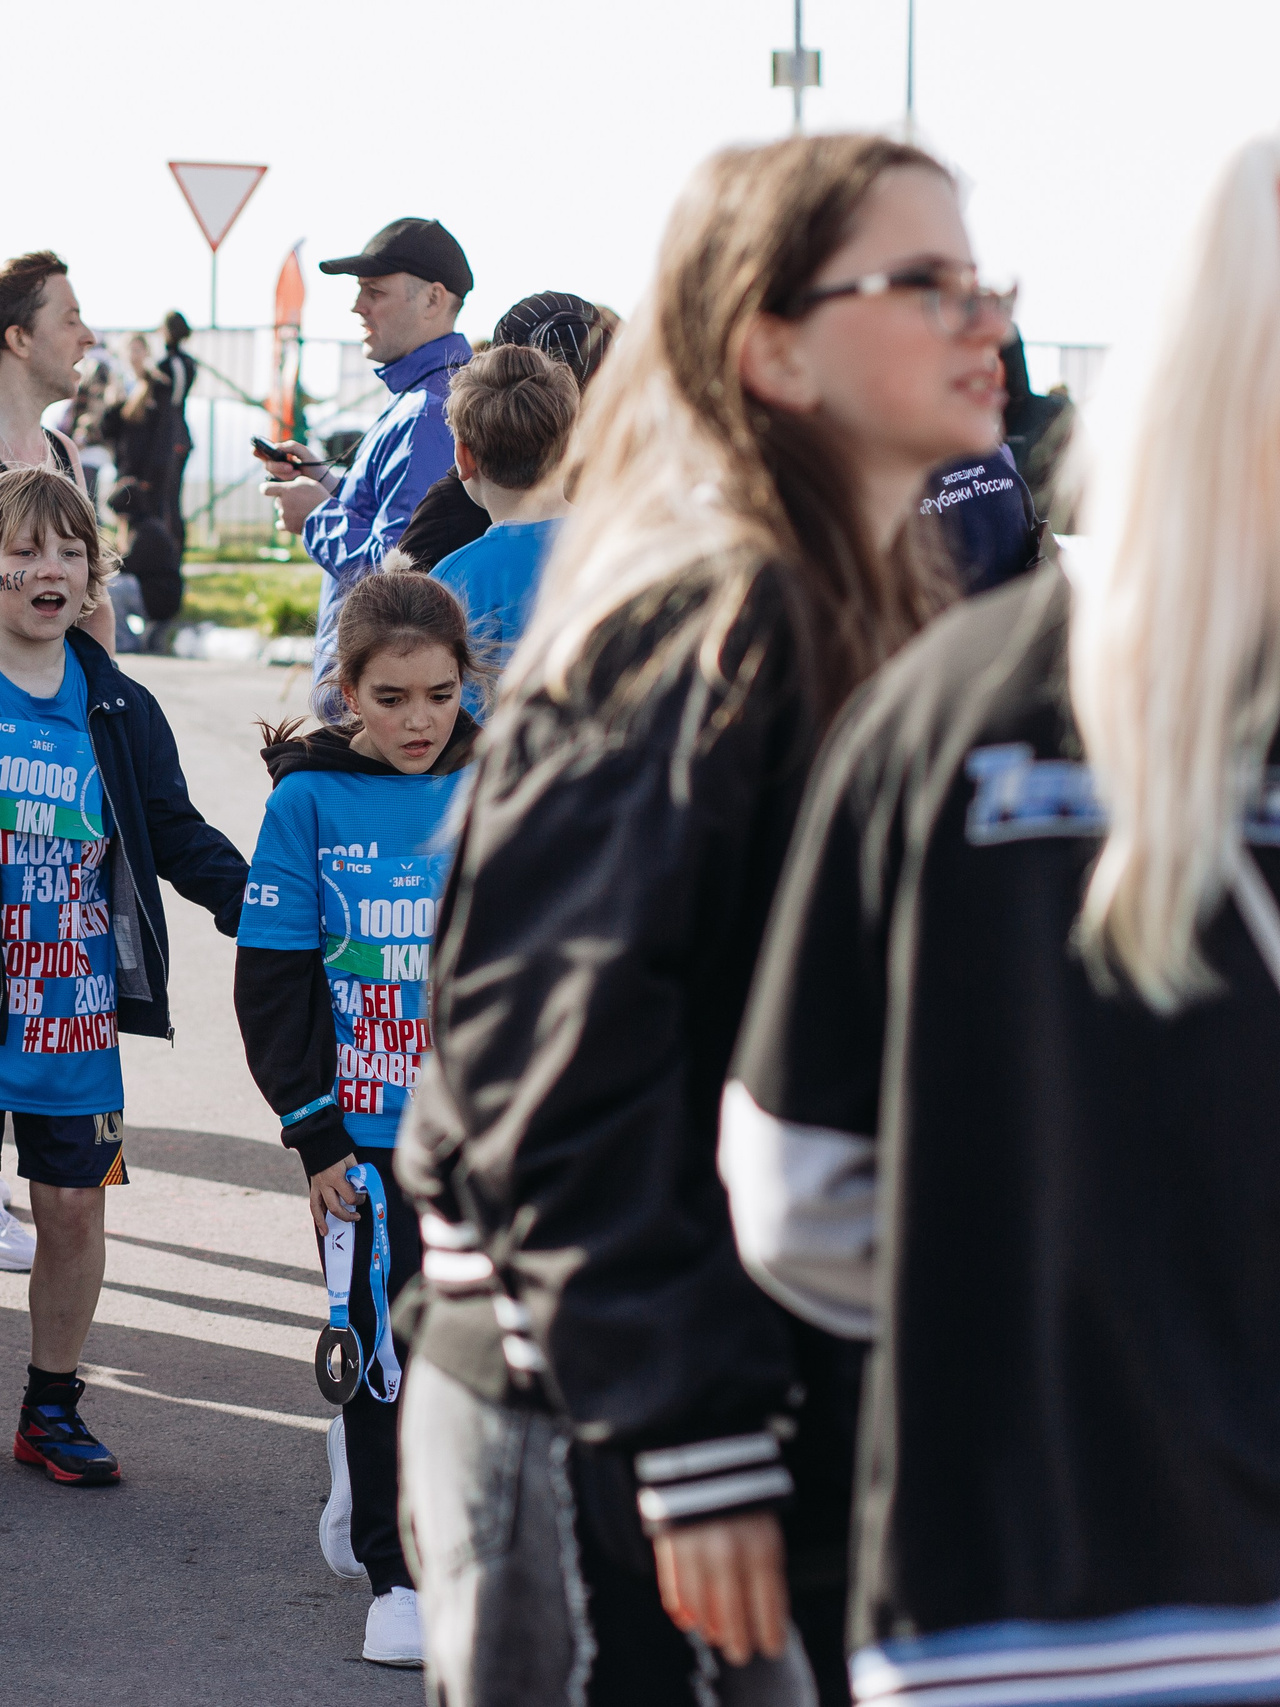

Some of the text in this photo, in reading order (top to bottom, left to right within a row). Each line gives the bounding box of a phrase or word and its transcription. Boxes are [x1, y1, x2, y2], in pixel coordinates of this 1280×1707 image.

[942, 465, 986, 486] ЭКСПЕДИЦИЯ
[920, 478, 1014, 515] «Рубежи России»
[0, 755, 78, 803] 10008
[346, 862, 372, 875] ПСБ
[243, 882, 280, 907] СБ
[358, 897, 445, 939] 1000
[74, 974, 115, 1015] 2024
[328, 979, 403, 1019] ЗАБЕГ
[338, 1079, 384, 1115] БЕГ
[93, 1111, 123, 1145] 10
